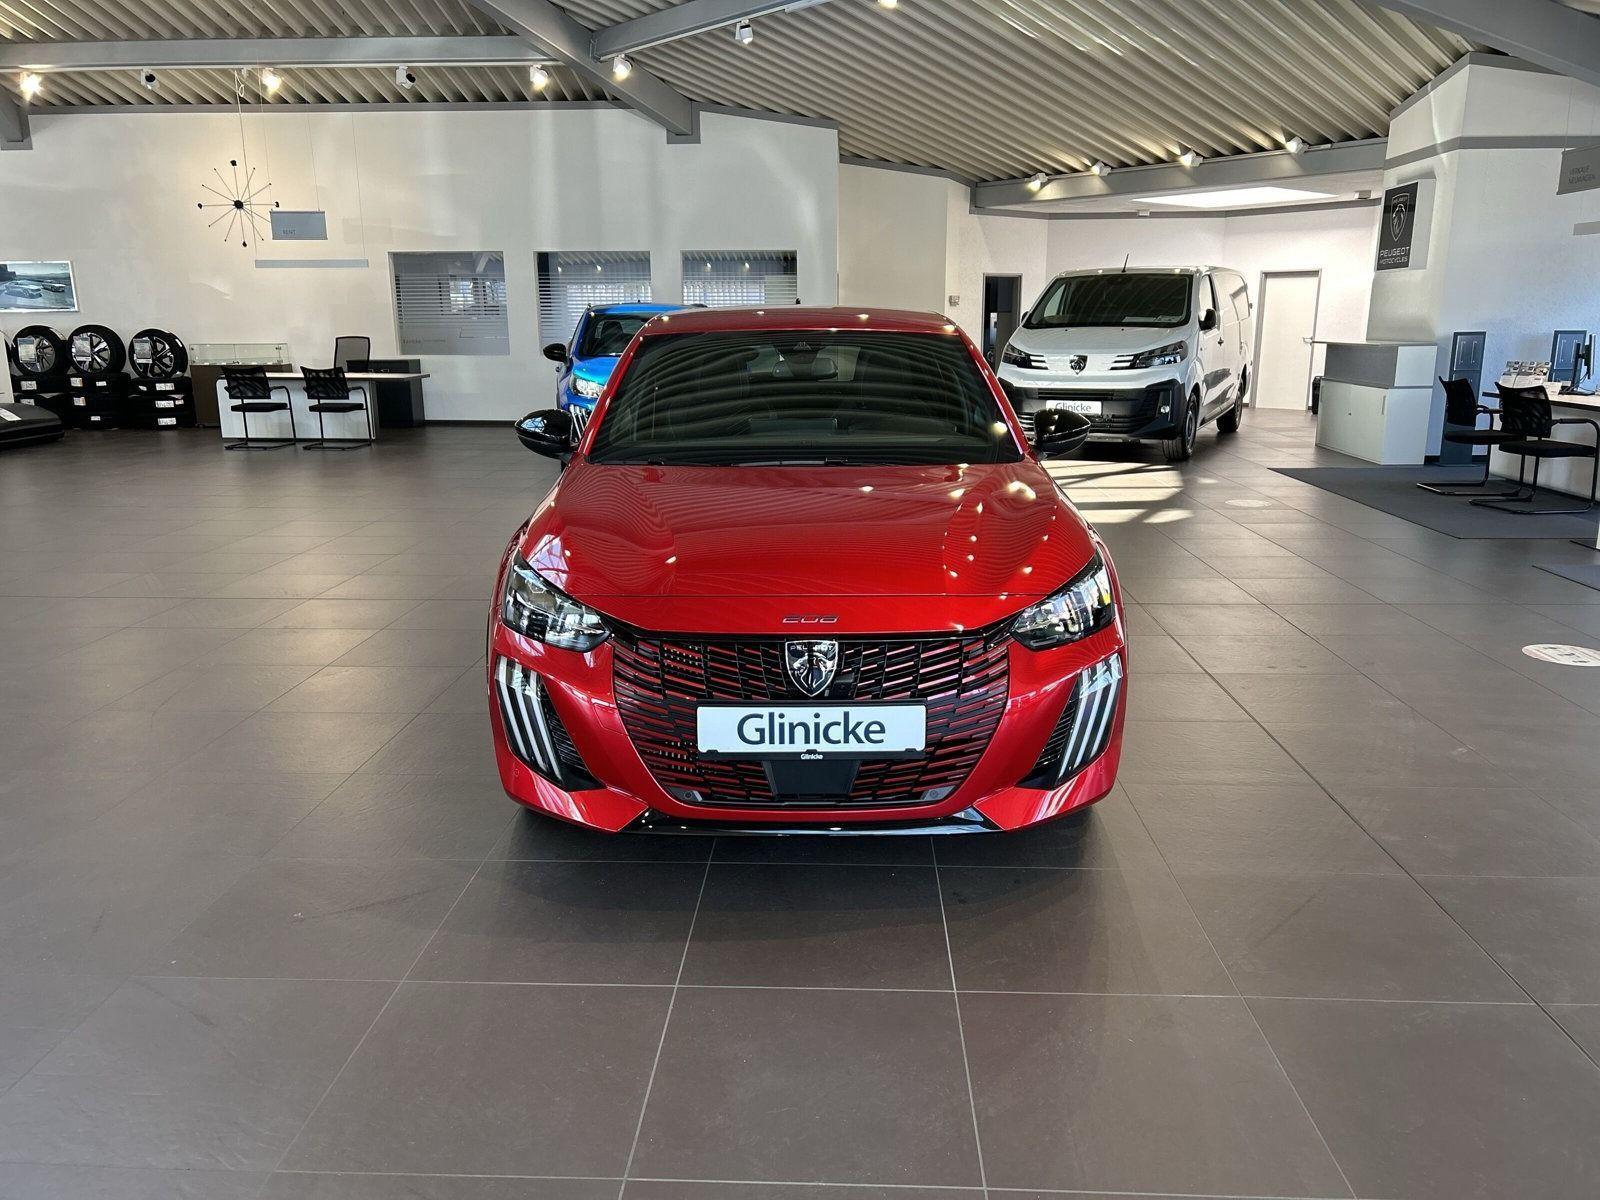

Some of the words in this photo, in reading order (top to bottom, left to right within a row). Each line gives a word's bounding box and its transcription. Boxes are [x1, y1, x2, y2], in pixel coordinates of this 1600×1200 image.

[1380, 247, 1410, 257] PEUGEOT
[1055, 402, 1092, 412] Glinicke
[737, 711, 886, 745] Glinicke
